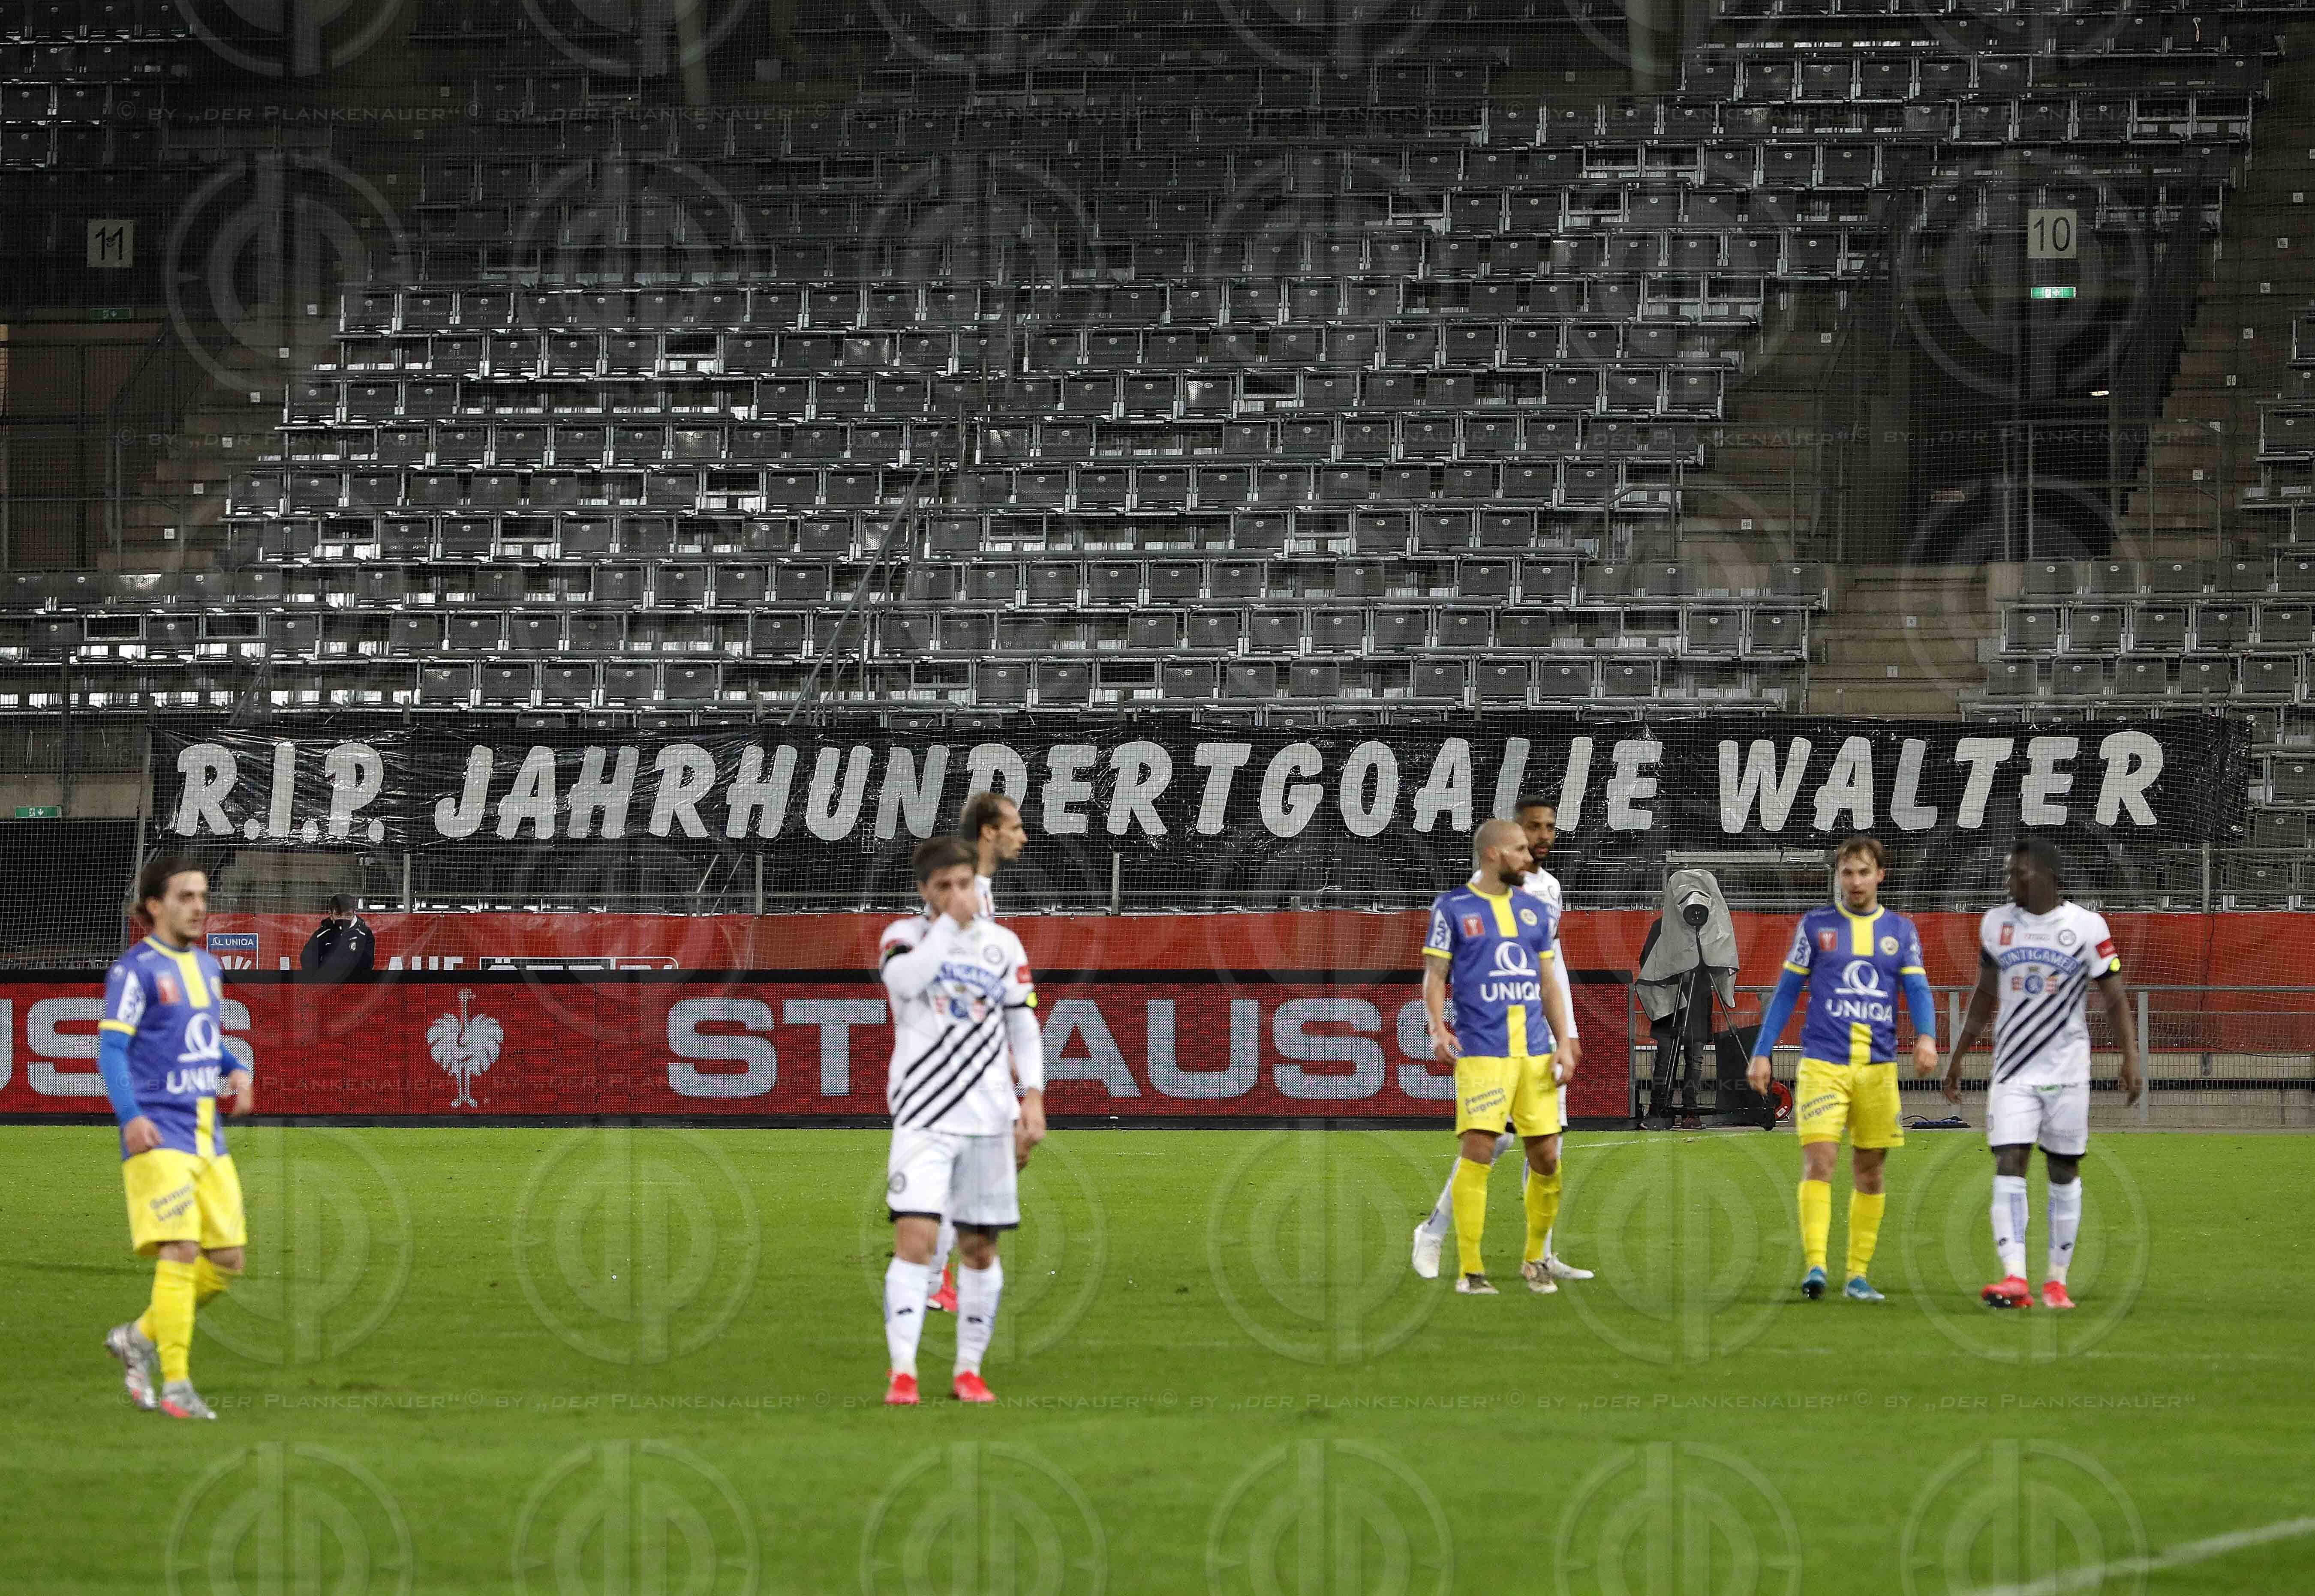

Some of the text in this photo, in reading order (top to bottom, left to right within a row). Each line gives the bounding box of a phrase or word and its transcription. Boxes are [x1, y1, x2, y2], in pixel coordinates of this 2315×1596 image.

[95, 226, 123, 260] 11
[2034, 216, 2070, 251] 10
[175, 731, 2164, 843] R.I.P. JAHRHUNDERTGOALIE WALTER
[1825, 999, 1893, 1023] UNIQA
[667, 998, 1456, 1099] STAUS
